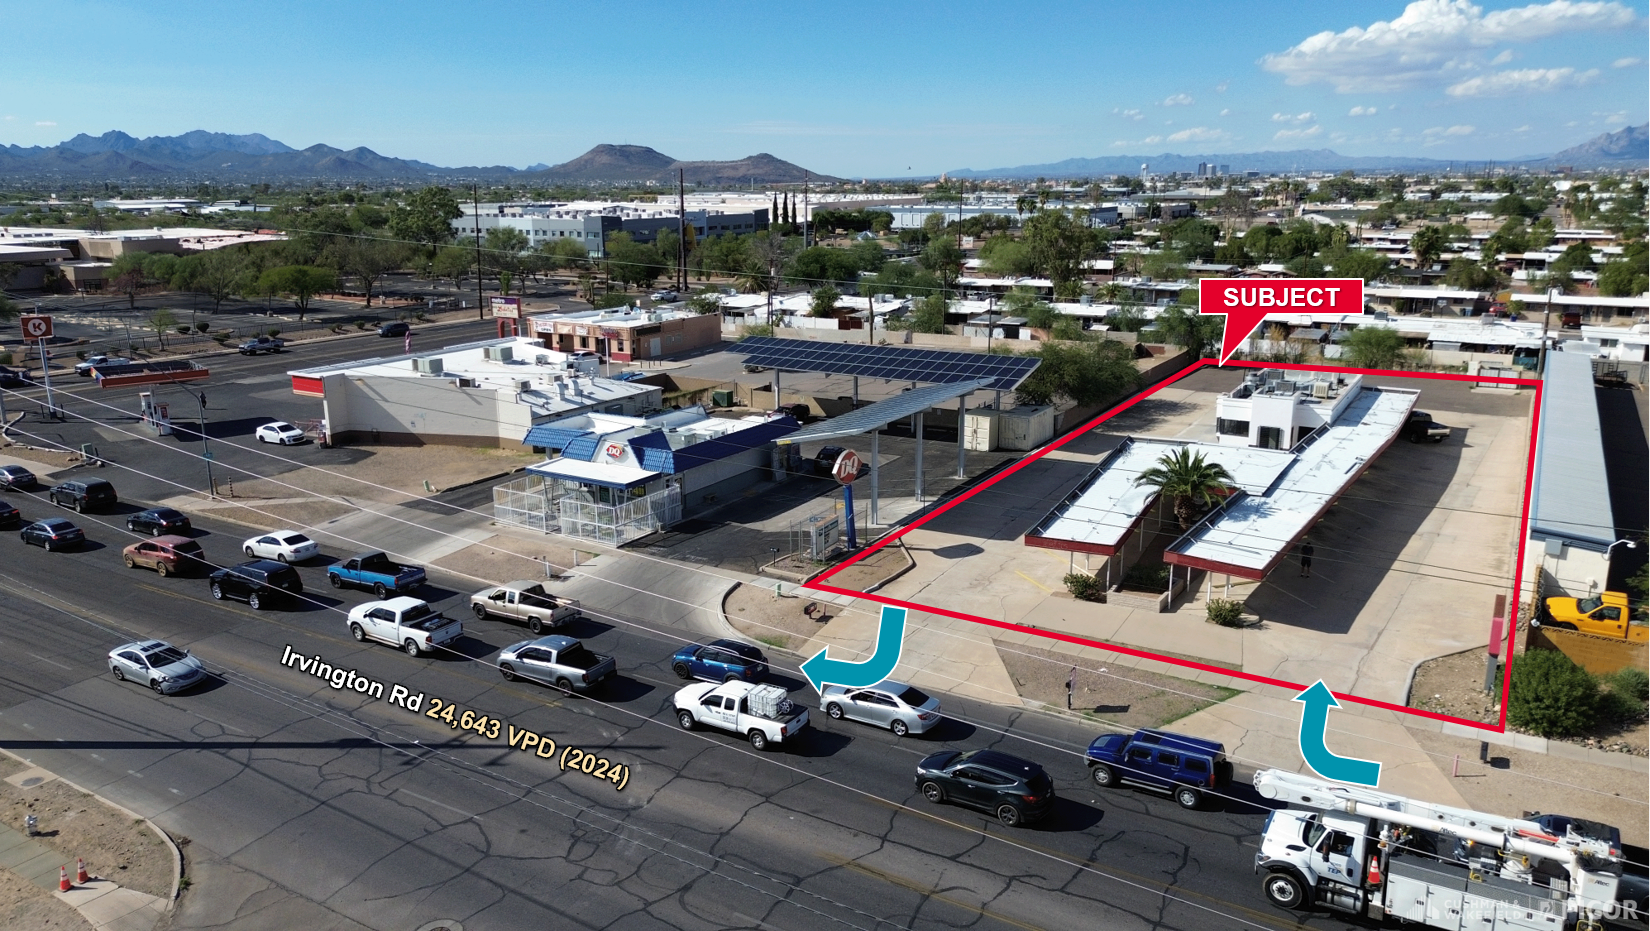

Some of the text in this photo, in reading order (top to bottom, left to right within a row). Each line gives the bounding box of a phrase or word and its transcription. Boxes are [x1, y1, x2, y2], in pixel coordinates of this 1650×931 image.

[32, 322, 44, 333] K
[608, 446, 621, 457] DQ
[840, 455, 859, 479] DQ
[1327, 866, 1342, 875] TEP
